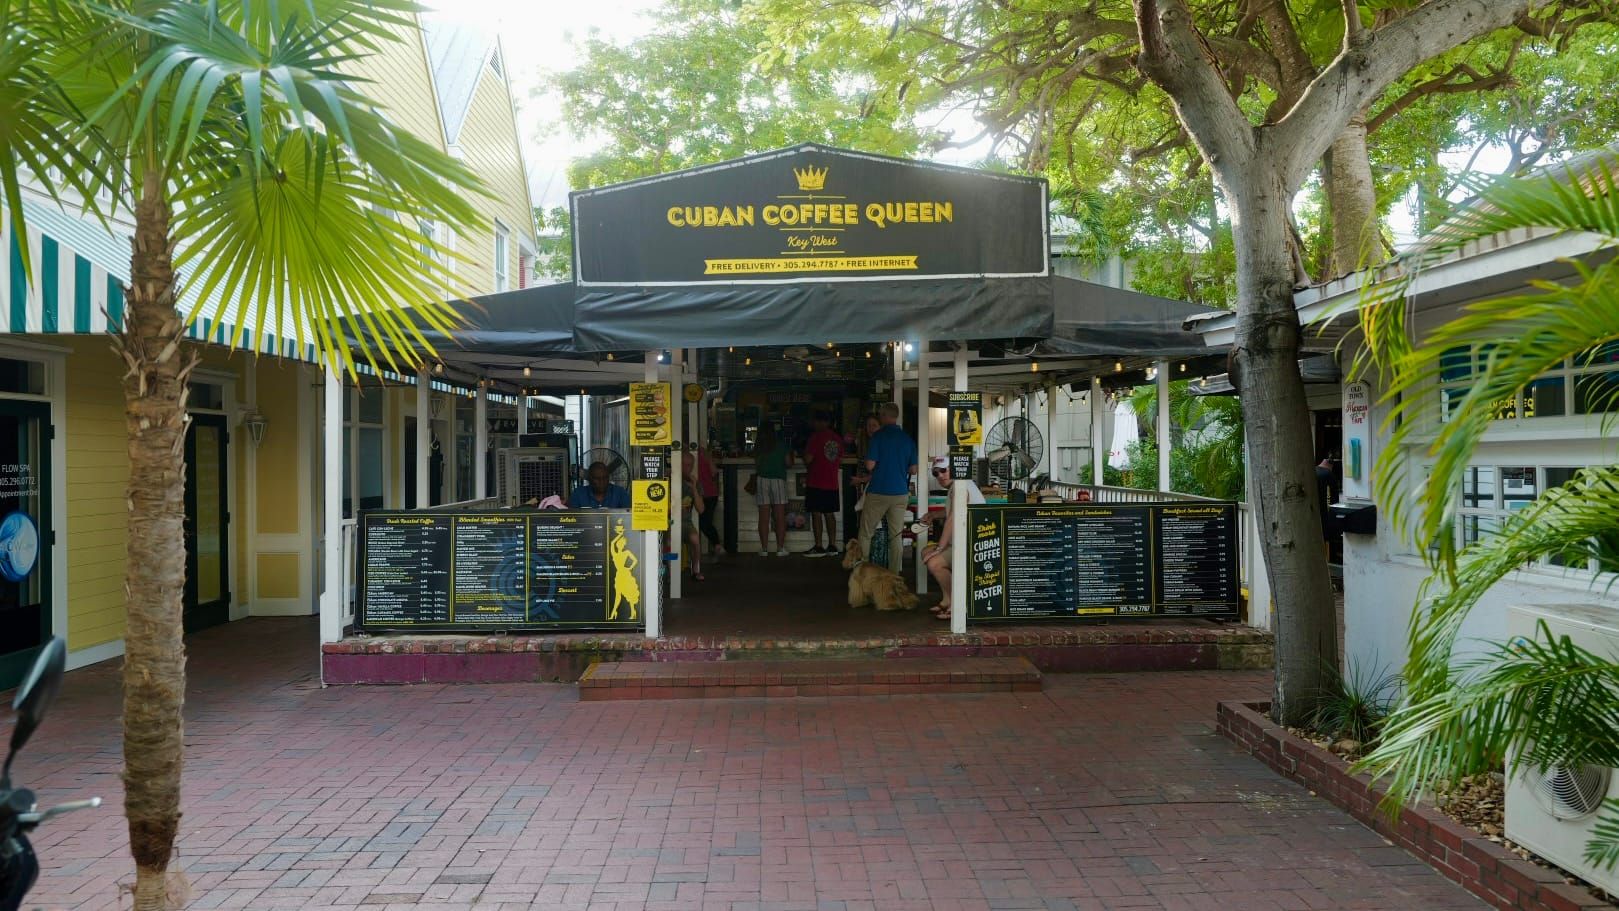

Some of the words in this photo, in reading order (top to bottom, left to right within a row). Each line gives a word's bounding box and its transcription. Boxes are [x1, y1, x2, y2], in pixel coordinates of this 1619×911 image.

[667, 205, 755, 228] CUBAN
[762, 203, 858, 226] COFFEE
[865, 201, 953, 229] QUEEN
[787, 235, 809, 250] Key
[810, 234, 838, 248] West
[711, 262, 732, 271] FREE
[735, 262, 776, 271] DELIVERY
[846, 259, 867, 269] FREE
[869, 258, 912, 268] INTERNET
[949, 393, 979, 401] SUBSCRIBE
[1, 464, 18, 473] FLOW
[19, 464, 31, 472] SPA
[1162, 508, 1186, 516] Breakfast
[419, 518, 435, 526] Coffee
[480, 516, 505, 524] Smoothies
[977, 521, 996, 534] Drink
[977, 531, 996, 540] more
[973, 537, 1000, 552] CUBAN
[973, 548, 1001, 563] COFFEE
[973, 584, 1003, 601] FASTER
